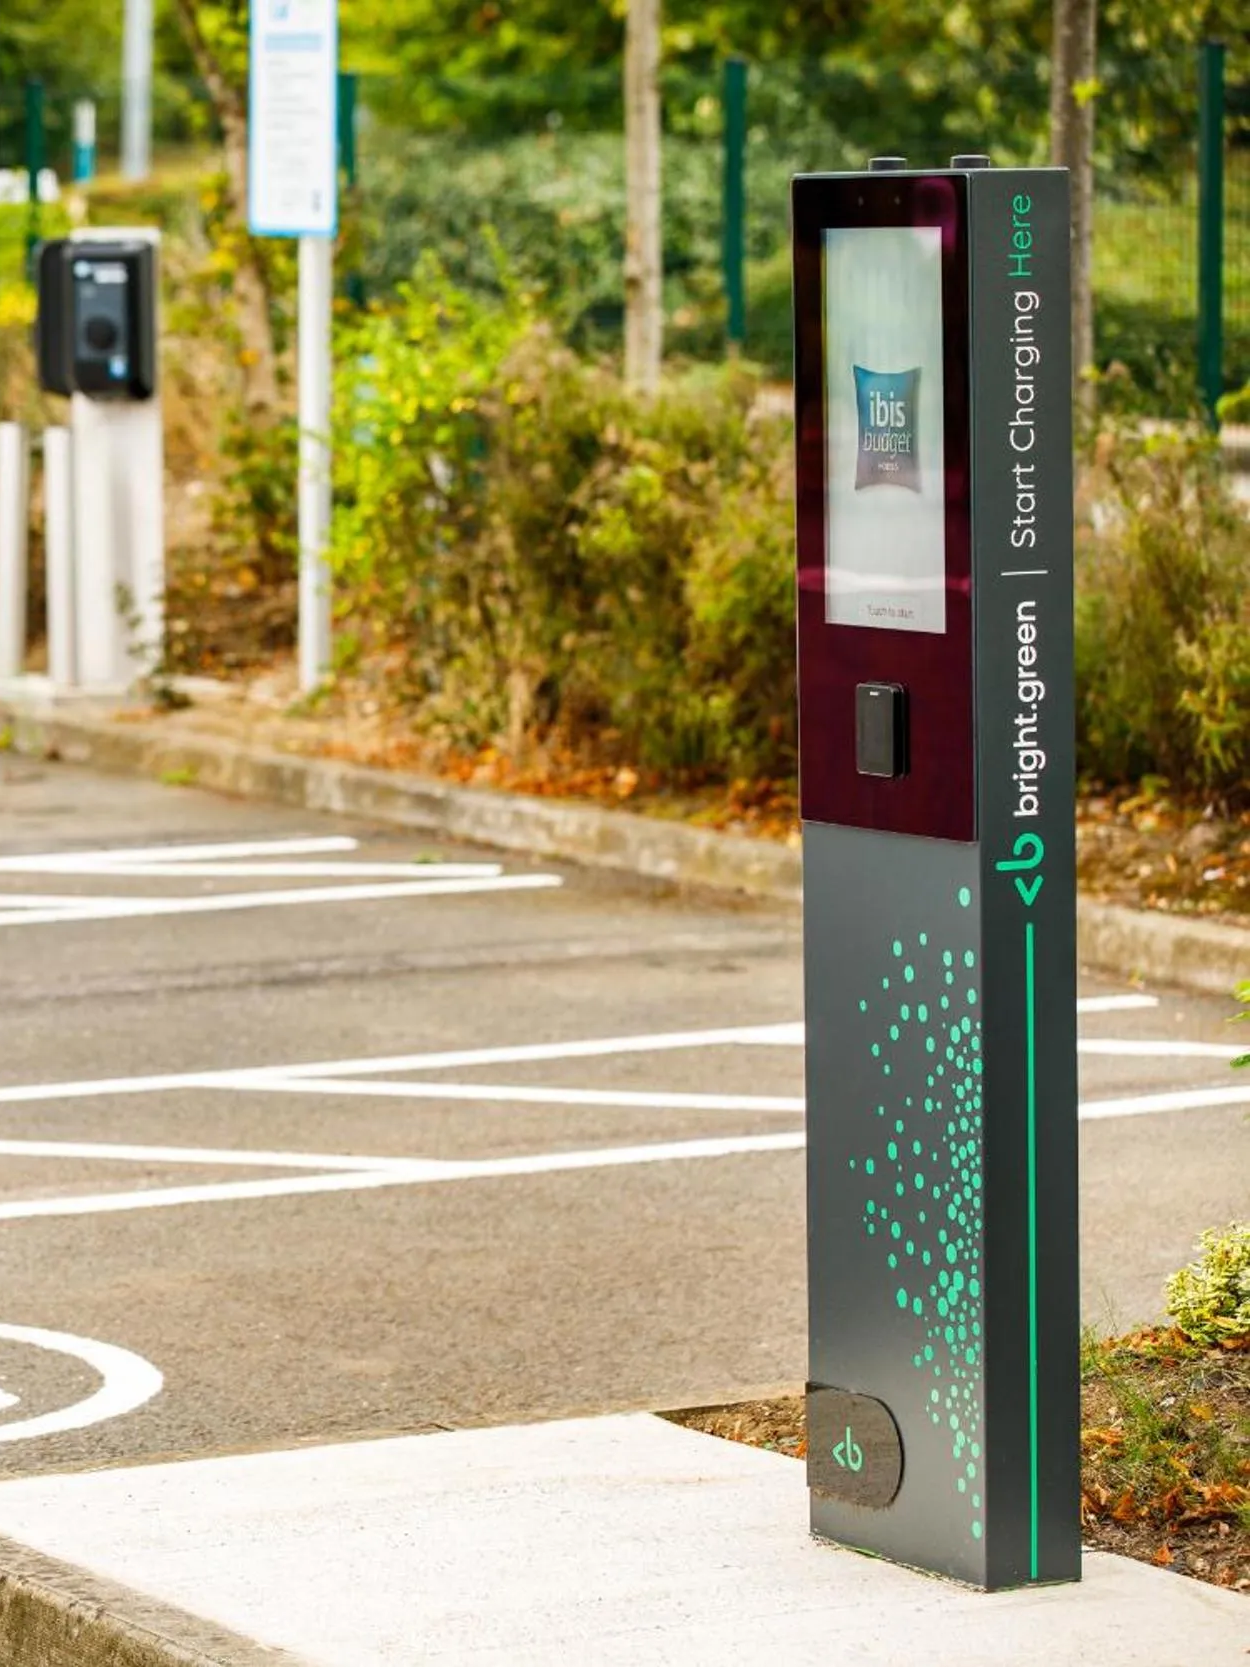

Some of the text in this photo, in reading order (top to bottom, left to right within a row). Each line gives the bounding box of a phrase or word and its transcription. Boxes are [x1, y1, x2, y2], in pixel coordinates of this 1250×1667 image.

[1008, 193, 1032, 277] Here
[869, 391, 906, 427] ibis
[1008, 290, 1040, 452] Charging
[1010, 463, 1035, 548] Start
[1013, 600, 1046, 817] bright.green
